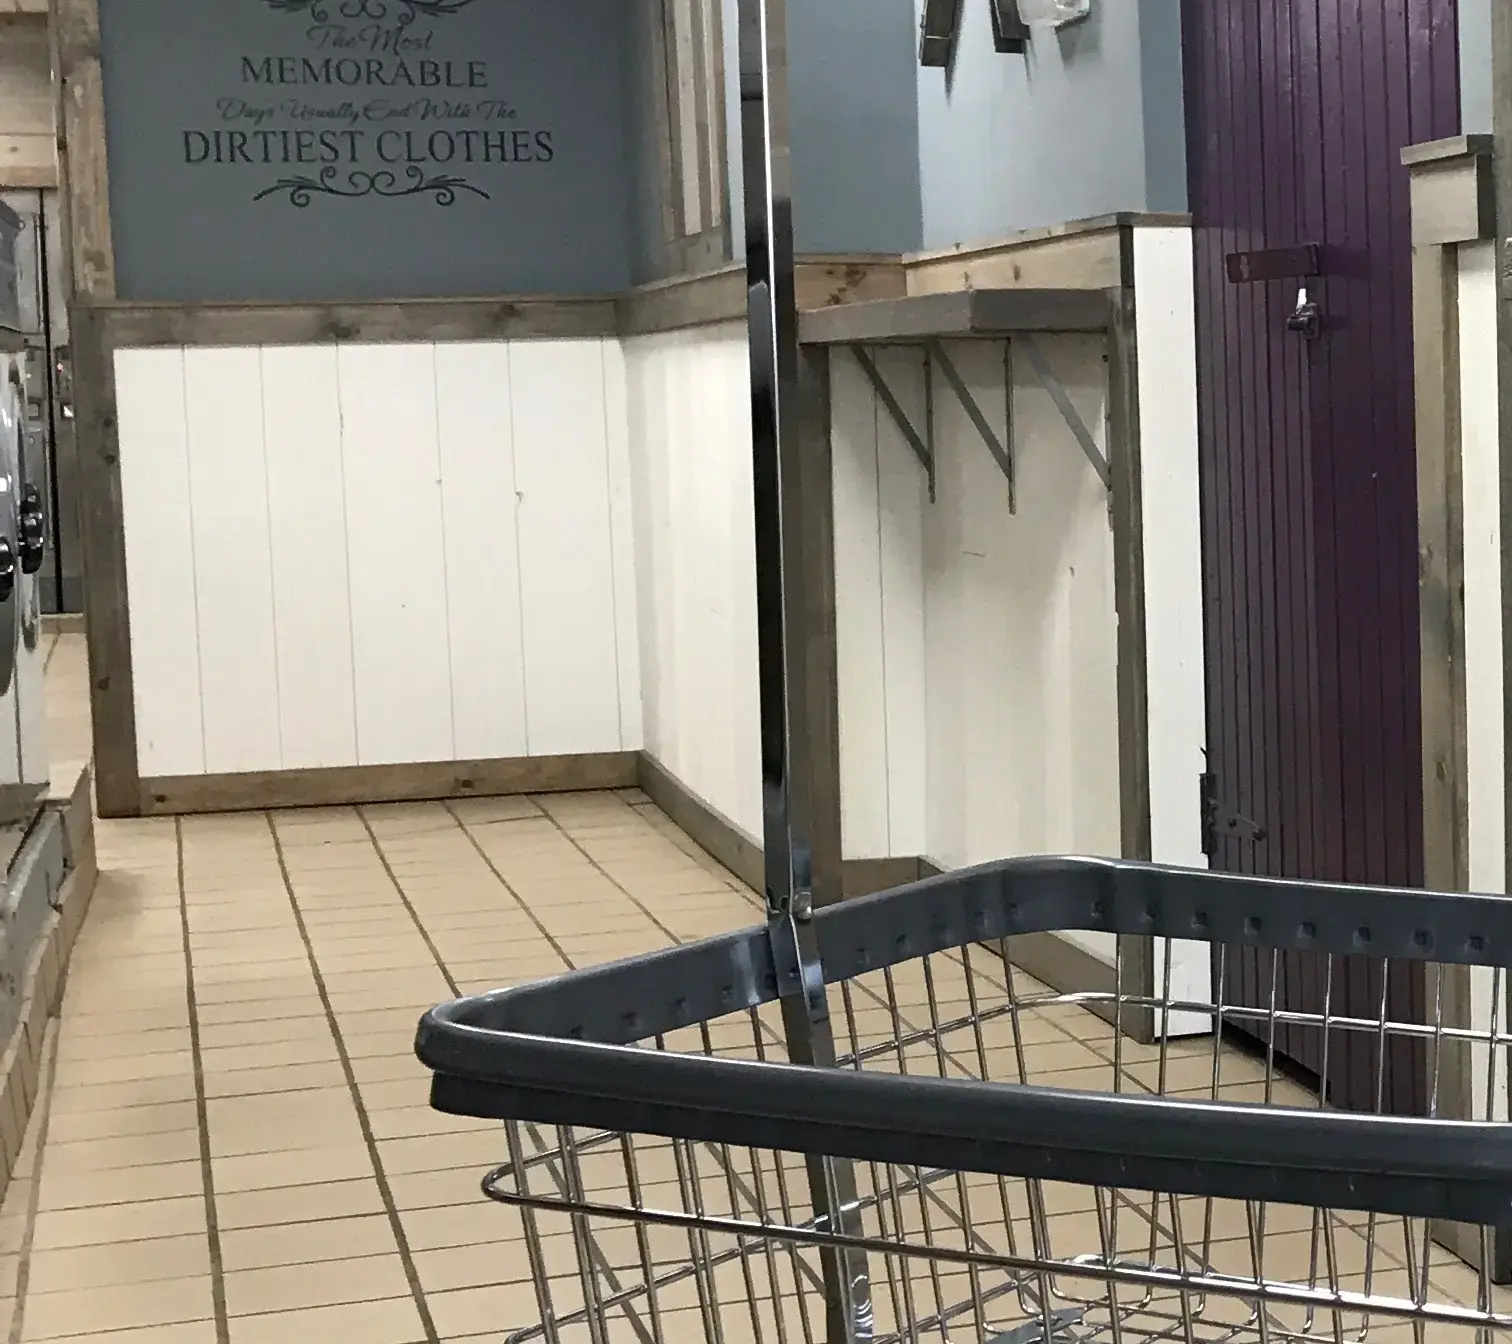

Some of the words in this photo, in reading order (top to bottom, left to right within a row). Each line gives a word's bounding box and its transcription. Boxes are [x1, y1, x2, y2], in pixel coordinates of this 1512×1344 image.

[306, 24, 357, 51] The
[357, 24, 433, 56] Most
[240, 56, 488, 88] MEMORABLE
[476, 99, 518, 120] The
[182, 129, 364, 164] DIRTIEST
[376, 130, 554, 163] CLOTHES
